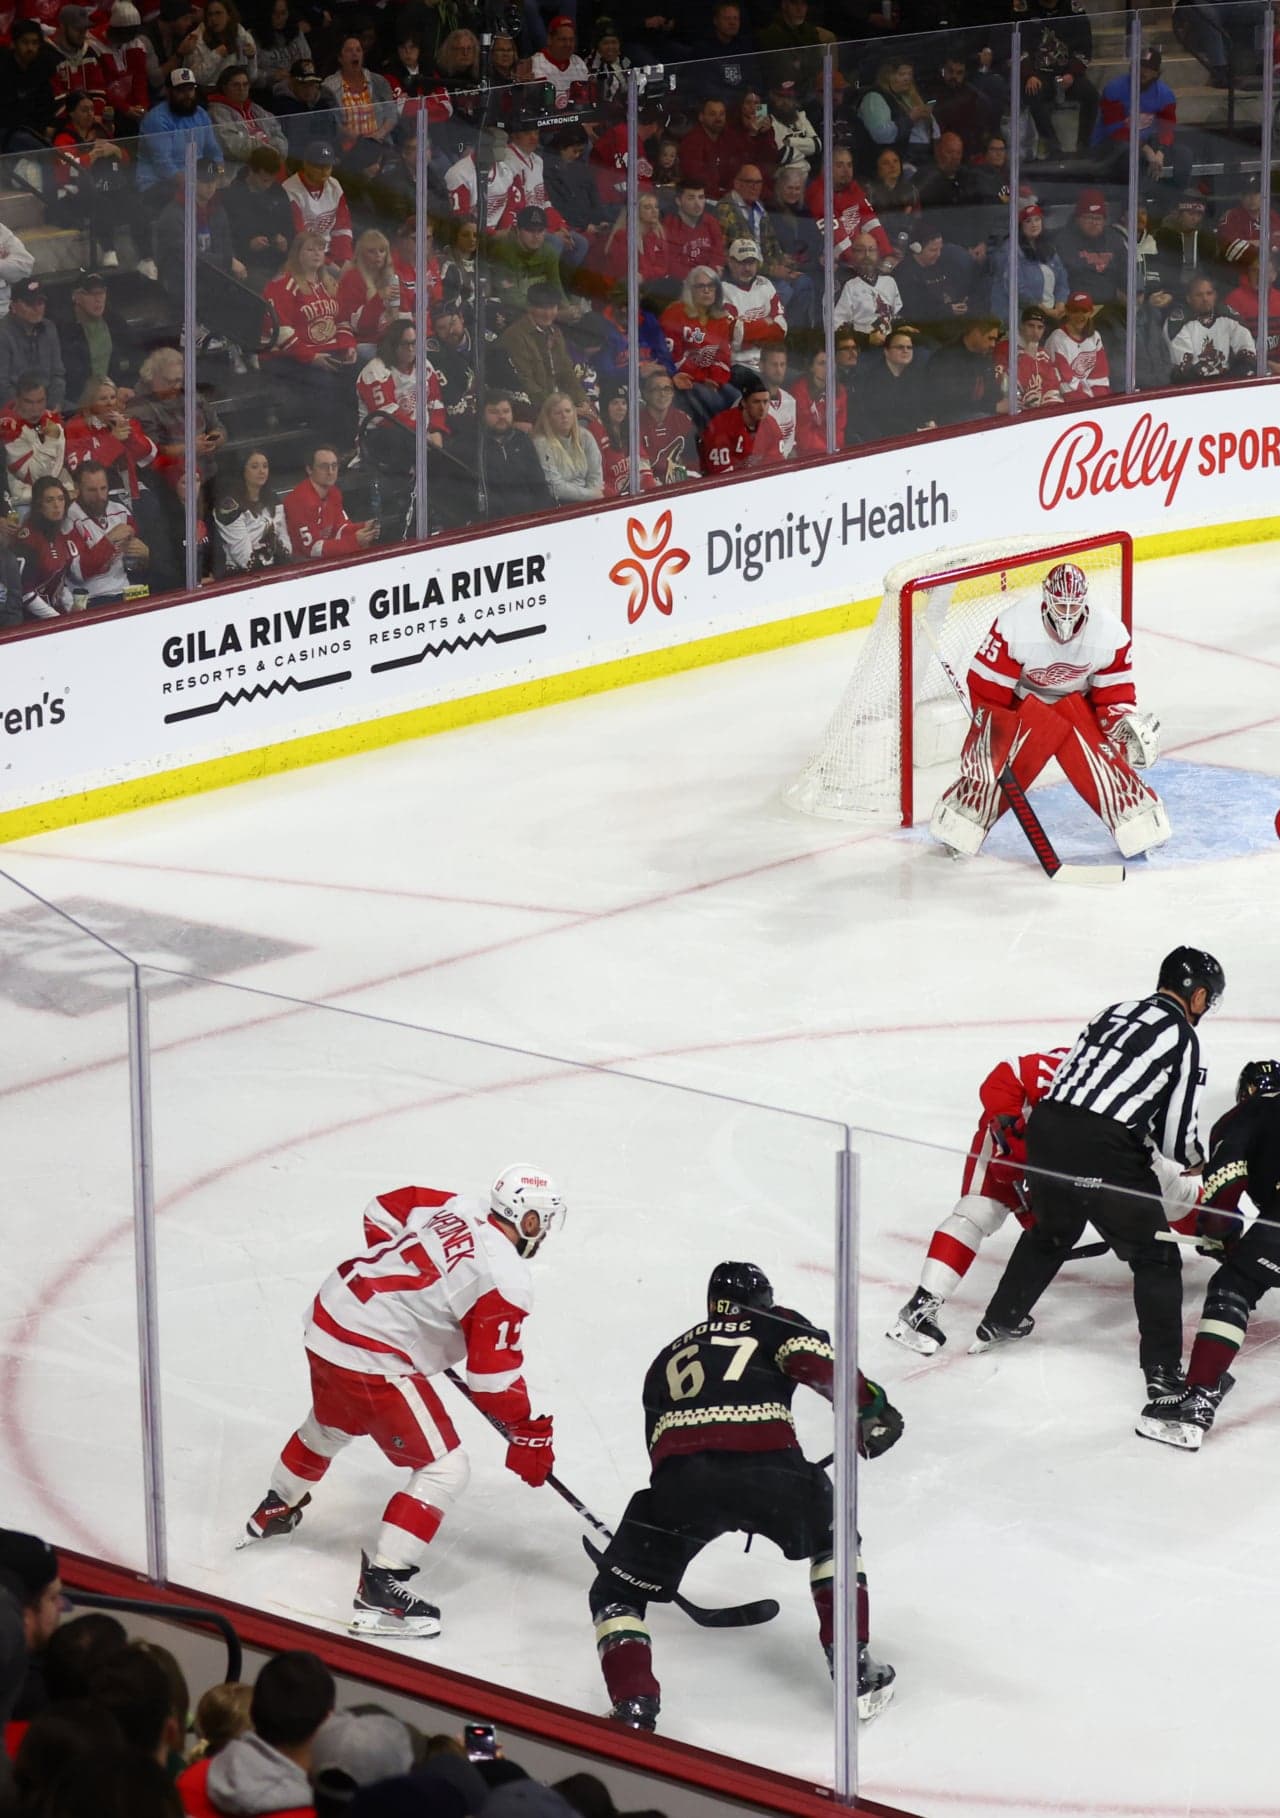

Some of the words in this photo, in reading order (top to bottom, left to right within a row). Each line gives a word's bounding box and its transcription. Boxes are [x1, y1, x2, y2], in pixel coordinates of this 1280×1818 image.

[708, 447, 730, 467] 40
[1038, 412, 1193, 511] Bally
[299, 526, 313, 546] 5
[707, 511, 833, 582] Dignity
[841, 480, 949, 545] Health
[369, 576, 445, 620] GILA
[451, 554, 546, 602] RIVER
[162, 623, 242, 668] GILA
[250, 598, 351, 649] RIVER
[369, 617, 448, 645] RESORTS
[457, 613, 466, 625] &
[474, 594, 548, 620] CASINOS
[162, 664, 247, 695] RESORTS
[256, 660, 266, 672] &
[274, 639, 352, 667] CASINOS
[0, 691, 66, 735] en's
[1098, 1016, 1143, 1049] 71
[1262, 1064, 1272, 1073] 17
[521, 1176, 548, 1188] meijer
[671, 1320, 752, 1351] CROUSE
[665, 1335, 759, 1401] 67
[610, 1566, 663, 1592] BAUER
